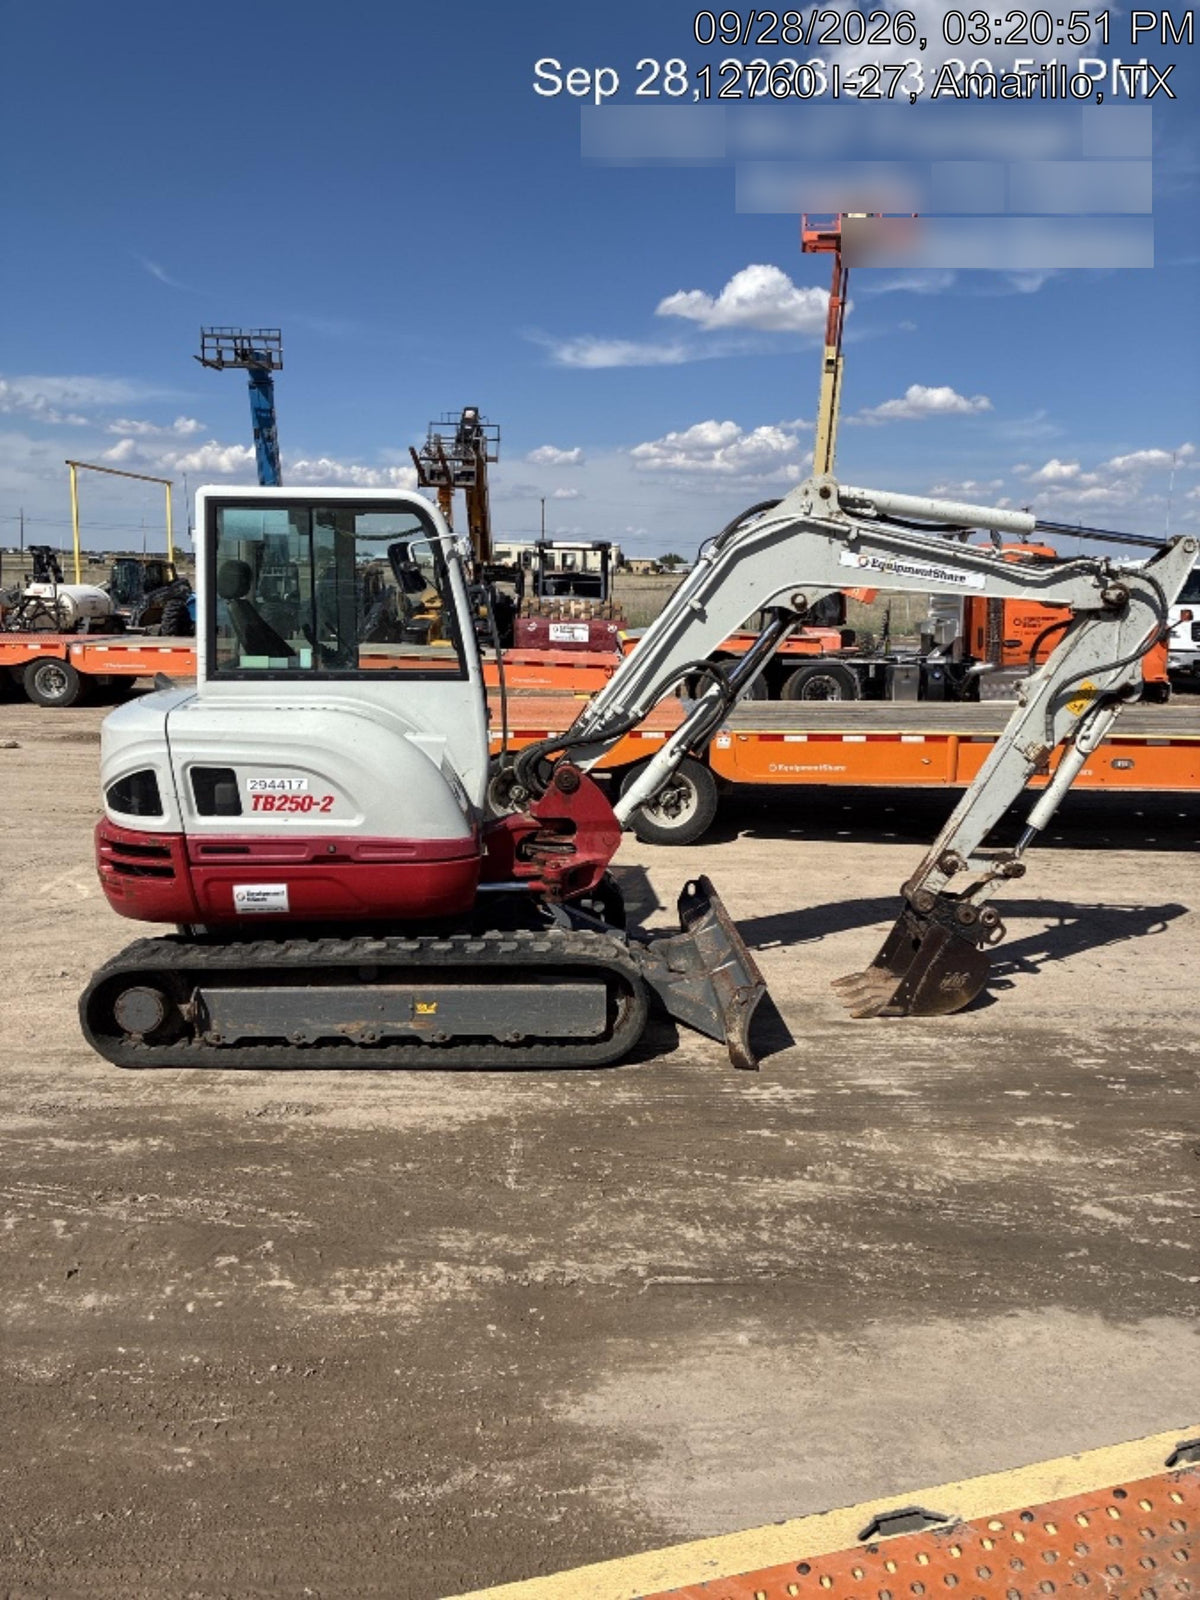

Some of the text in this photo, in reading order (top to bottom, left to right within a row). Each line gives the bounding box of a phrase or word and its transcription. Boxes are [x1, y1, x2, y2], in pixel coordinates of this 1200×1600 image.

[870, 558, 967, 583] EquipmentShare
[249, 780, 304, 790] 294417
[251, 794, 335, 813] TB250-2
